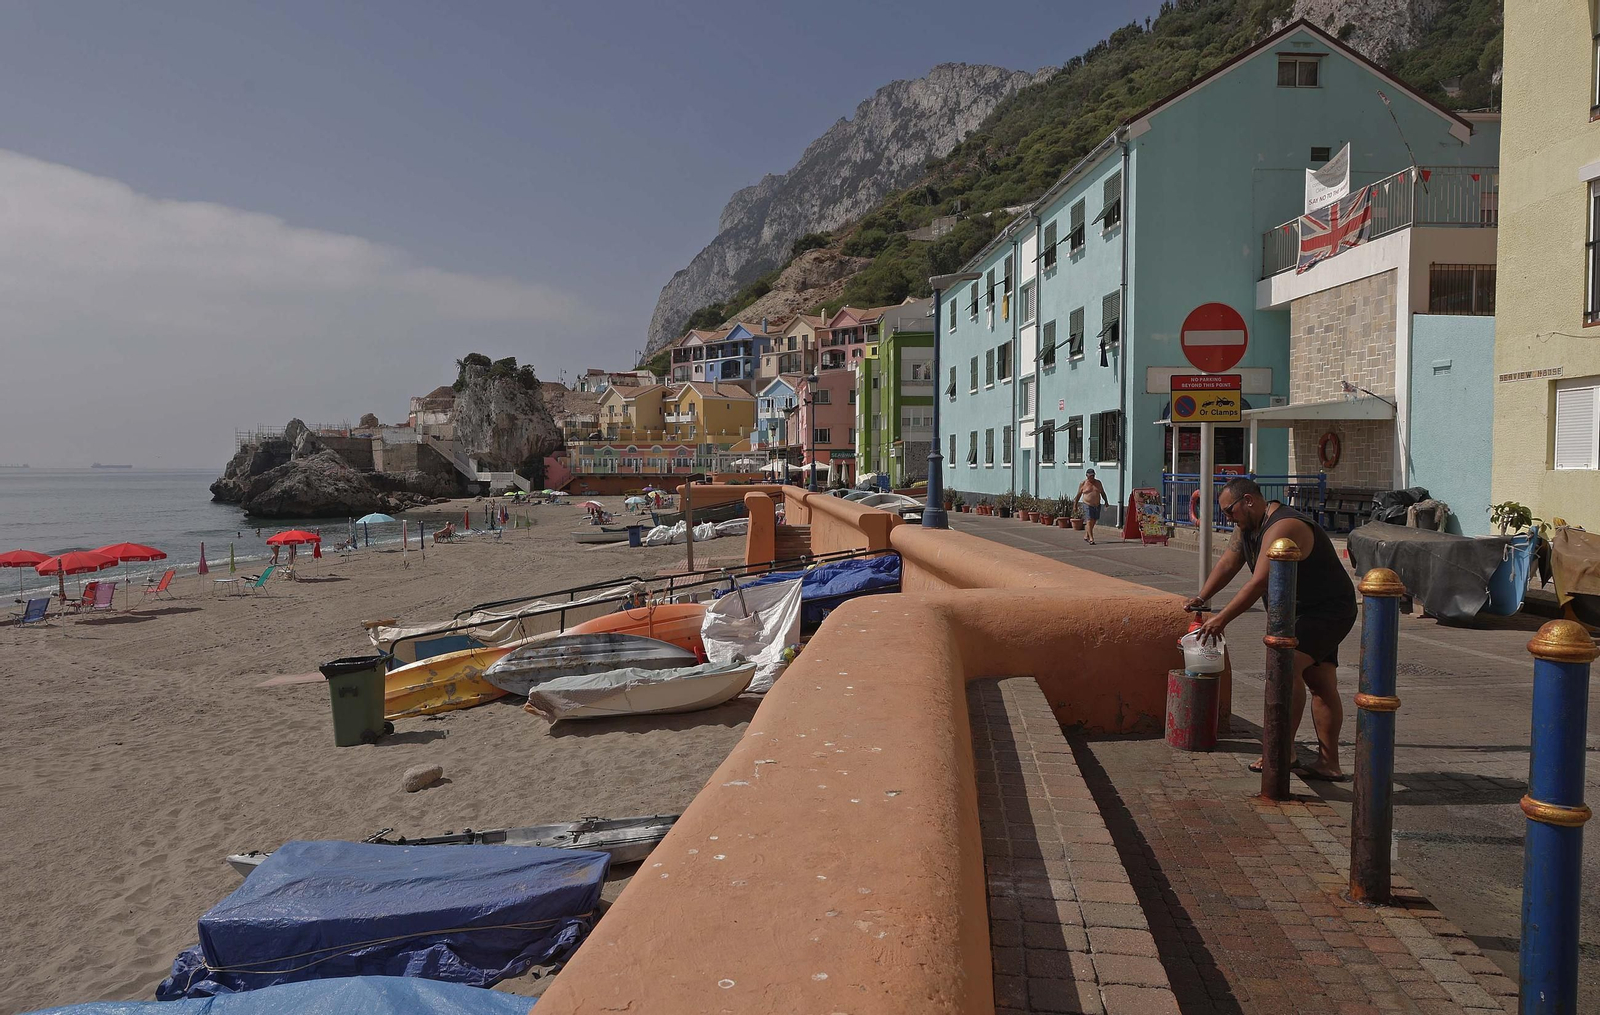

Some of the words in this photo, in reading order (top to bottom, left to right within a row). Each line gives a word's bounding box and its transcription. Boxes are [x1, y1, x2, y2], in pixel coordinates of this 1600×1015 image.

[1319, 194, 1327, 202] NO
[1499, 372, 1532, 382] SEAVIEW
[1537, 368, 1562, 377] HOUSE
